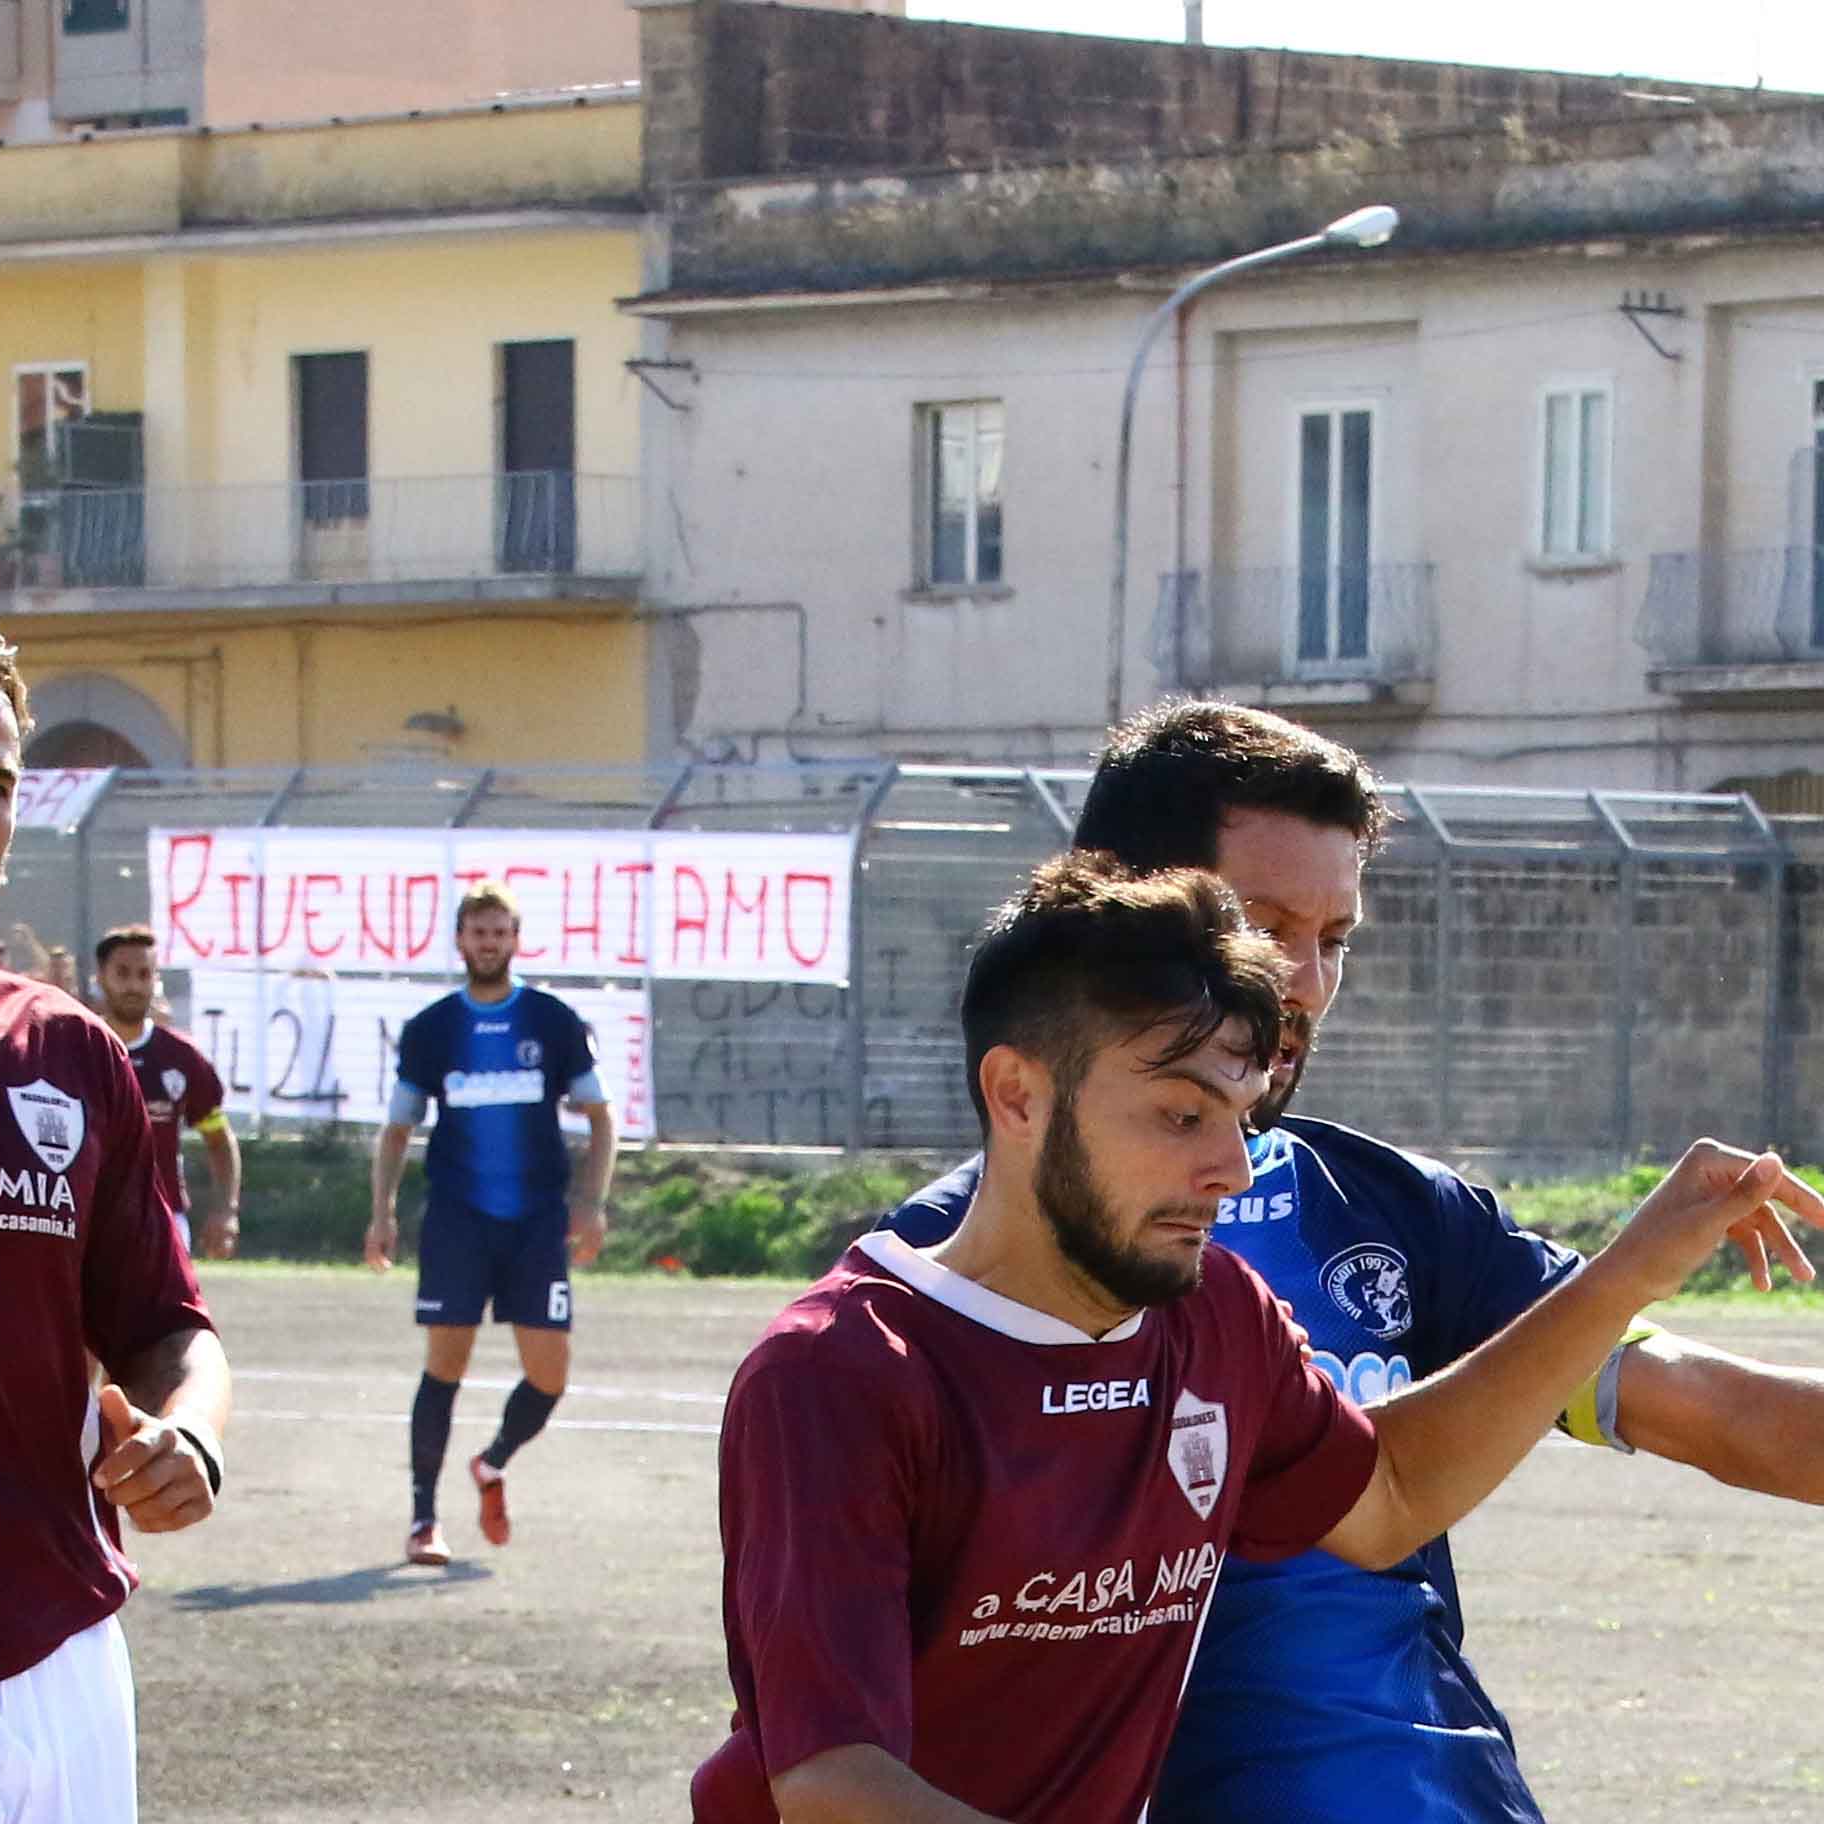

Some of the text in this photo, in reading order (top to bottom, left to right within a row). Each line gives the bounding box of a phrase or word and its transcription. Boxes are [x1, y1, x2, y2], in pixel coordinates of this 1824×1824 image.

[268, 1010, 349, 1101] 24
[1215, 1191, 1294, 1225] eus
[547, 1280, 570, 1322] 6
[1042, 1378, 1152, 1415] LEGEA
[972, 1593, 1001, 1620] a
[1015, 1559, 1136, 1614] CASA
